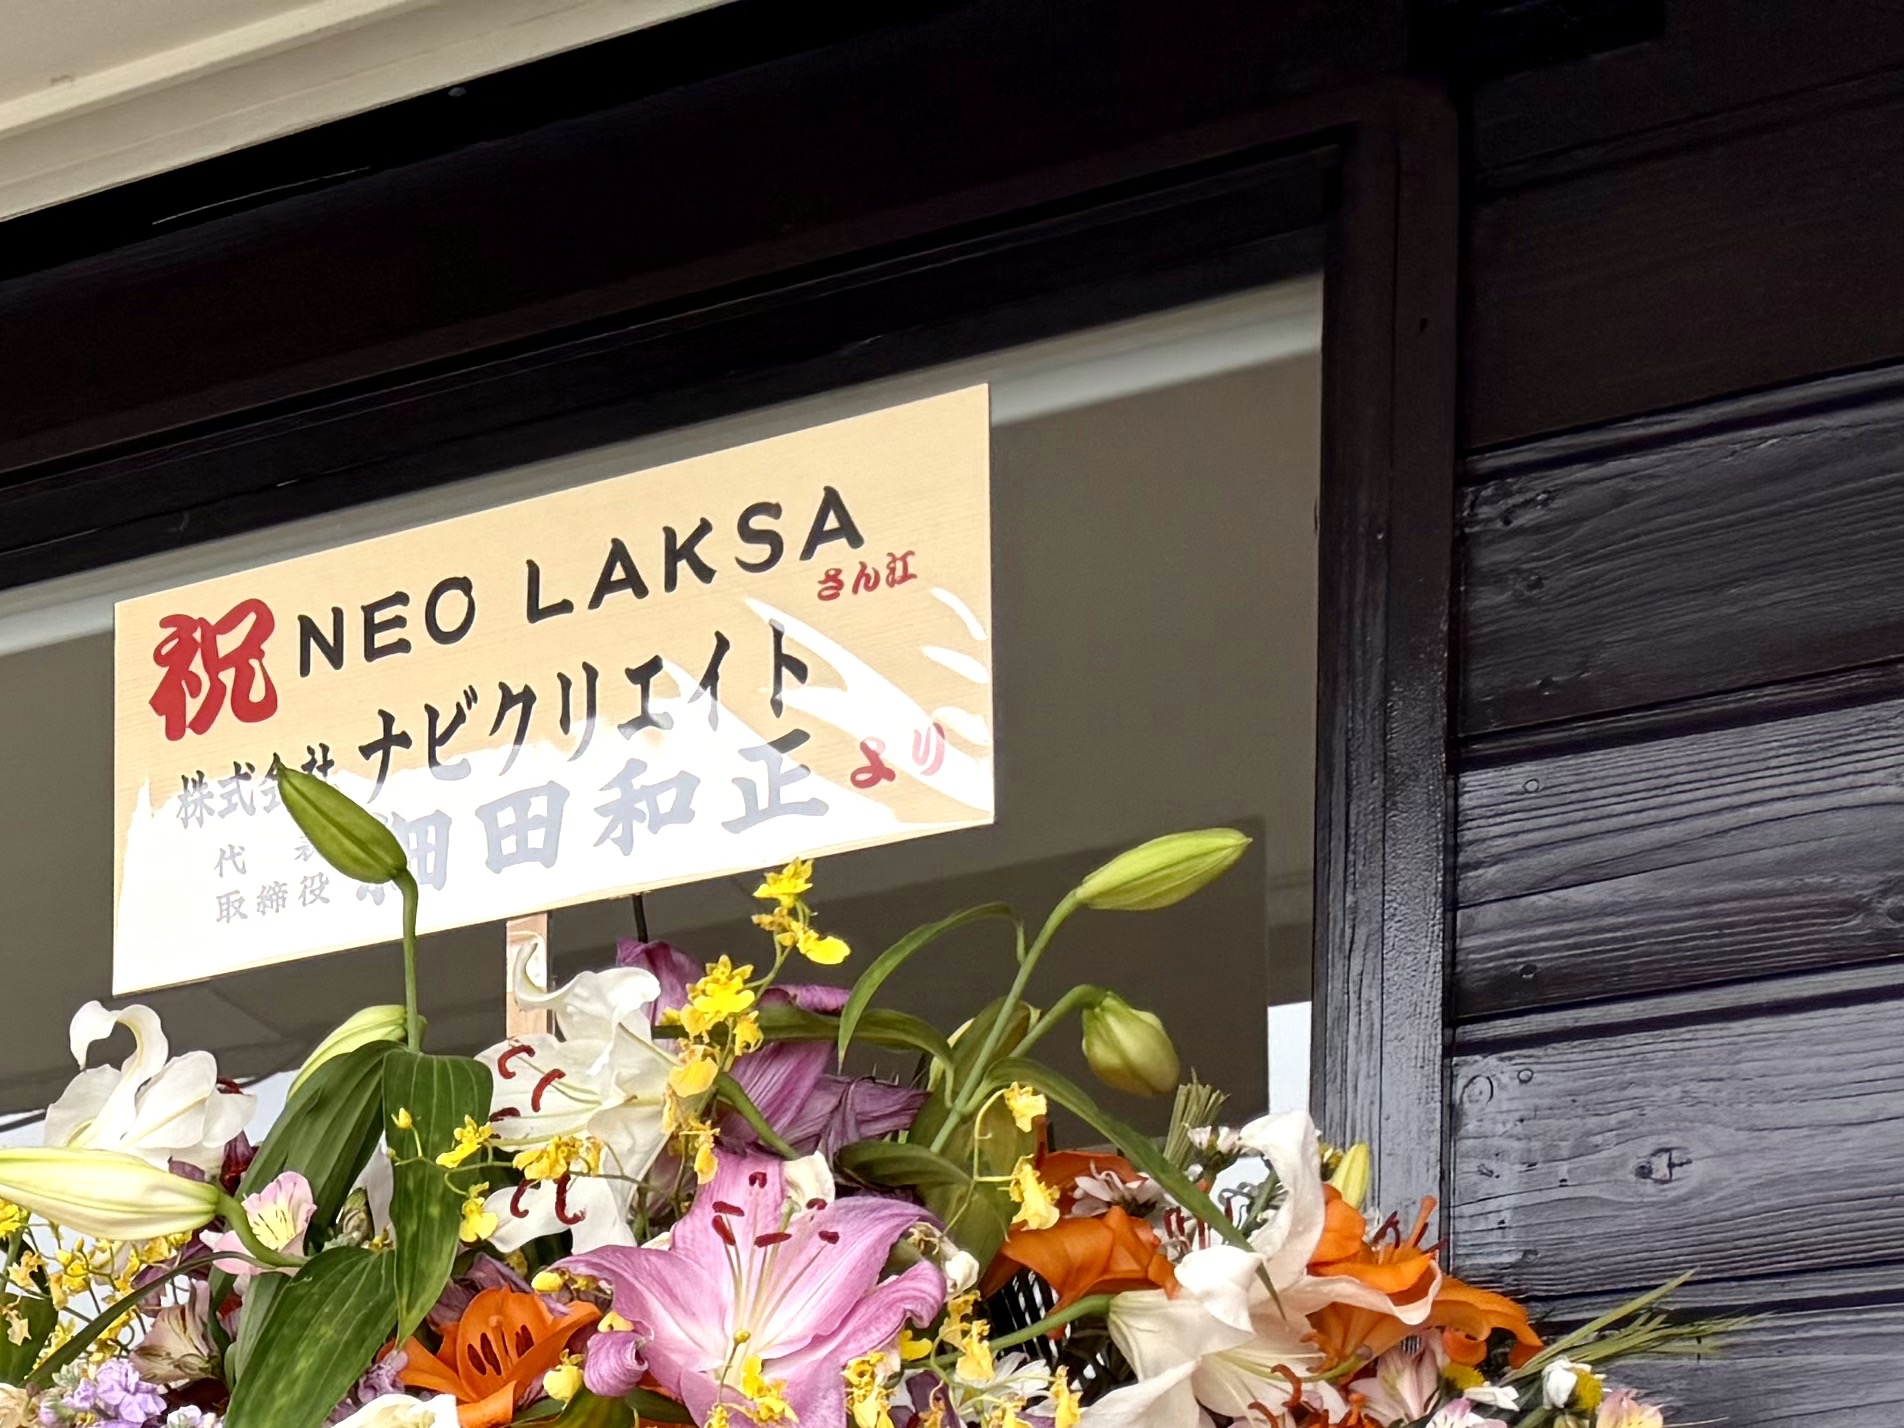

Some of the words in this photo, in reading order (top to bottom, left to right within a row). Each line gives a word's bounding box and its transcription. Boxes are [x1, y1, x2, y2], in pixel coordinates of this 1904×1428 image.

[148, 597, 279, 742] 祝
[296, 575, 477, 679] NEO
[526, 484, 866, 625] LAKSA
[358, 618, 809, 805] ナビクリエイト
[850, 721, 946, 789] より
[216, 872, 331, 925] 取締役
